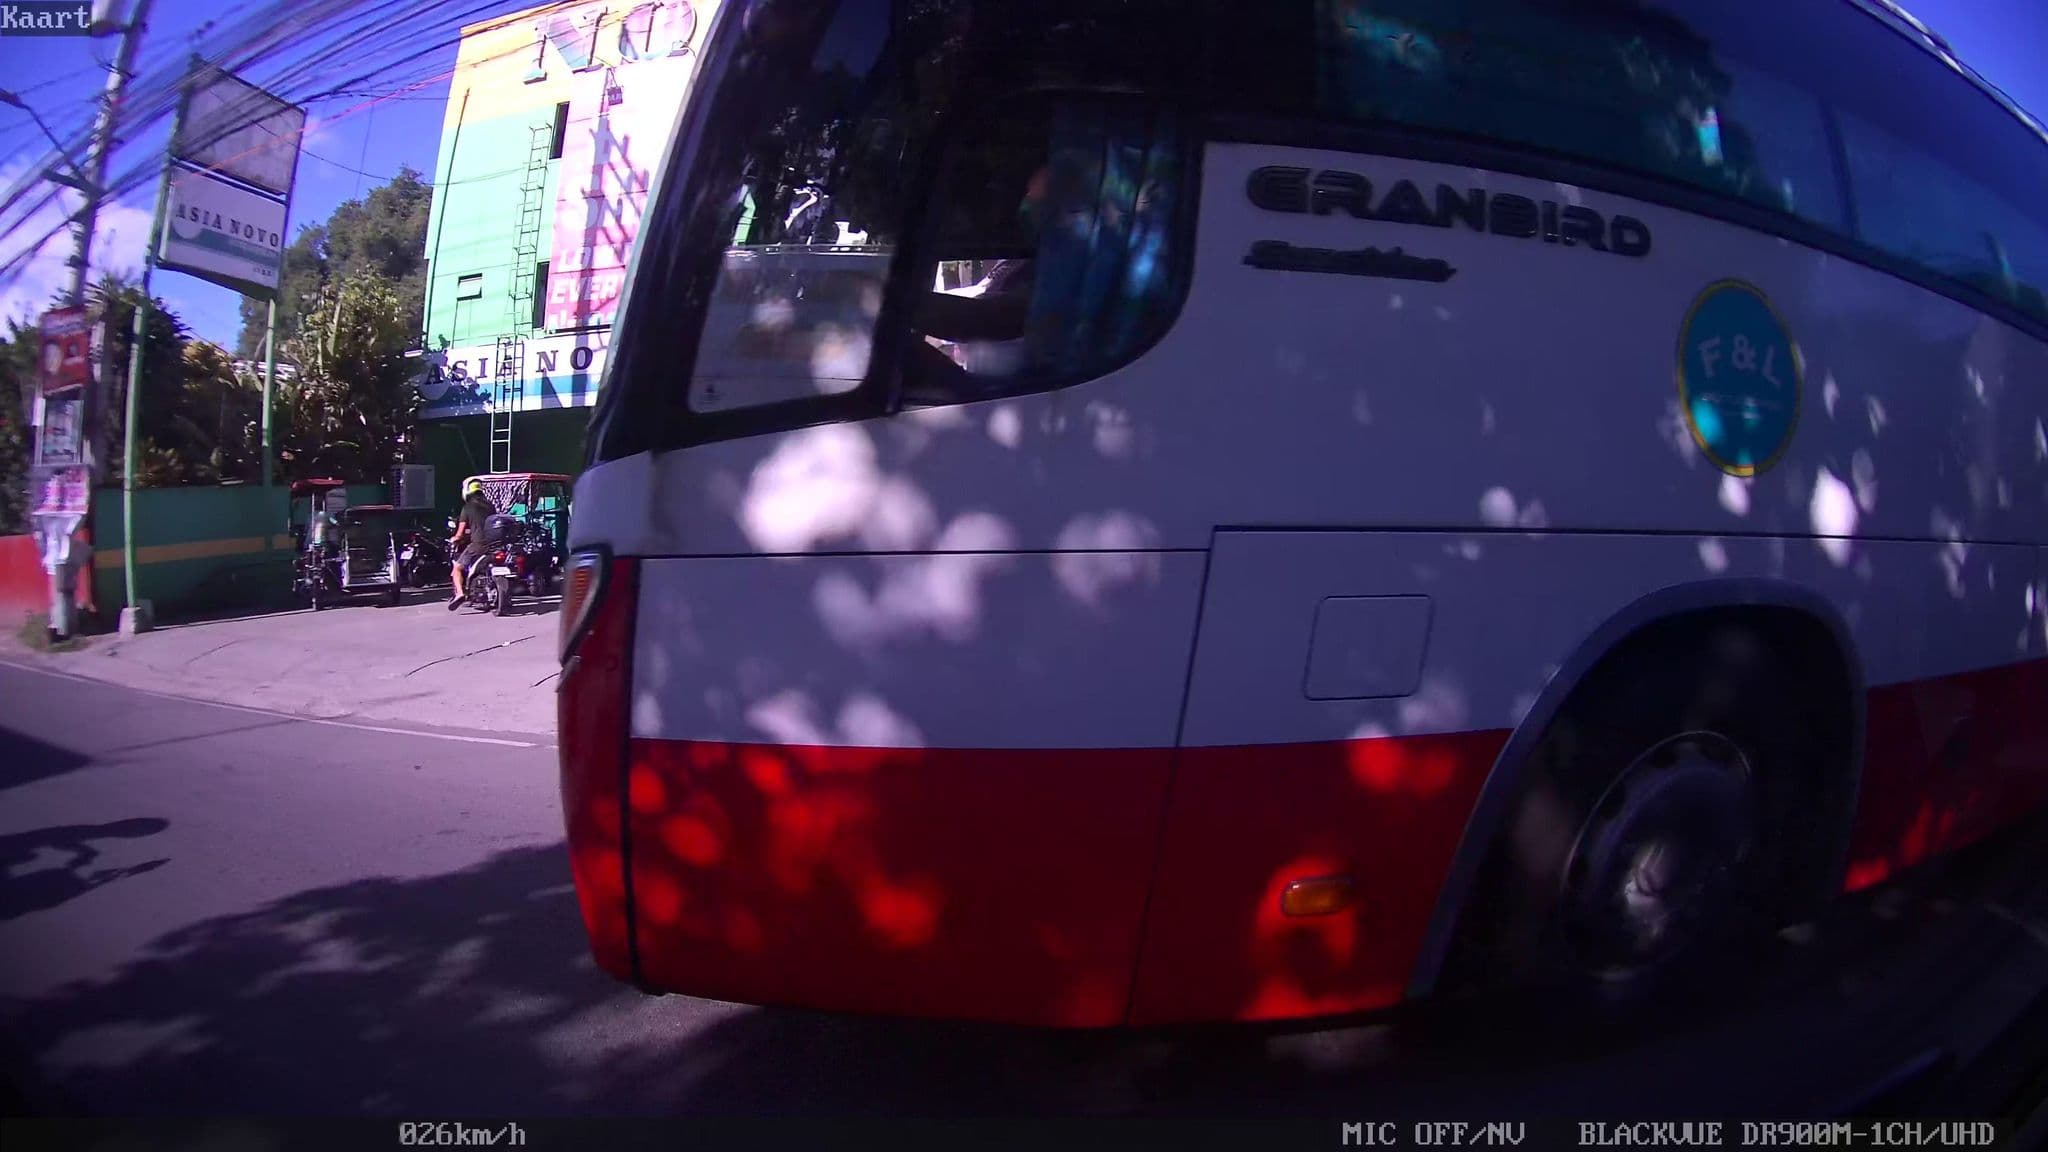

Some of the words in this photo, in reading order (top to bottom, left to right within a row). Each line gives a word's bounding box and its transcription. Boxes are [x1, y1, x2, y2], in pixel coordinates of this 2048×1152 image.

[175, 203, 222, 230] ASIA
[229, 218, 280, 247] NOVO
[1246, 165, 1653, 257] GRANBIRD
[425, 354, 518, 385] ASIA
[1697, 335, 1723, 379] F
[1731, 333, 1758, 371] &
[1761, 345, 1782, 390] L
